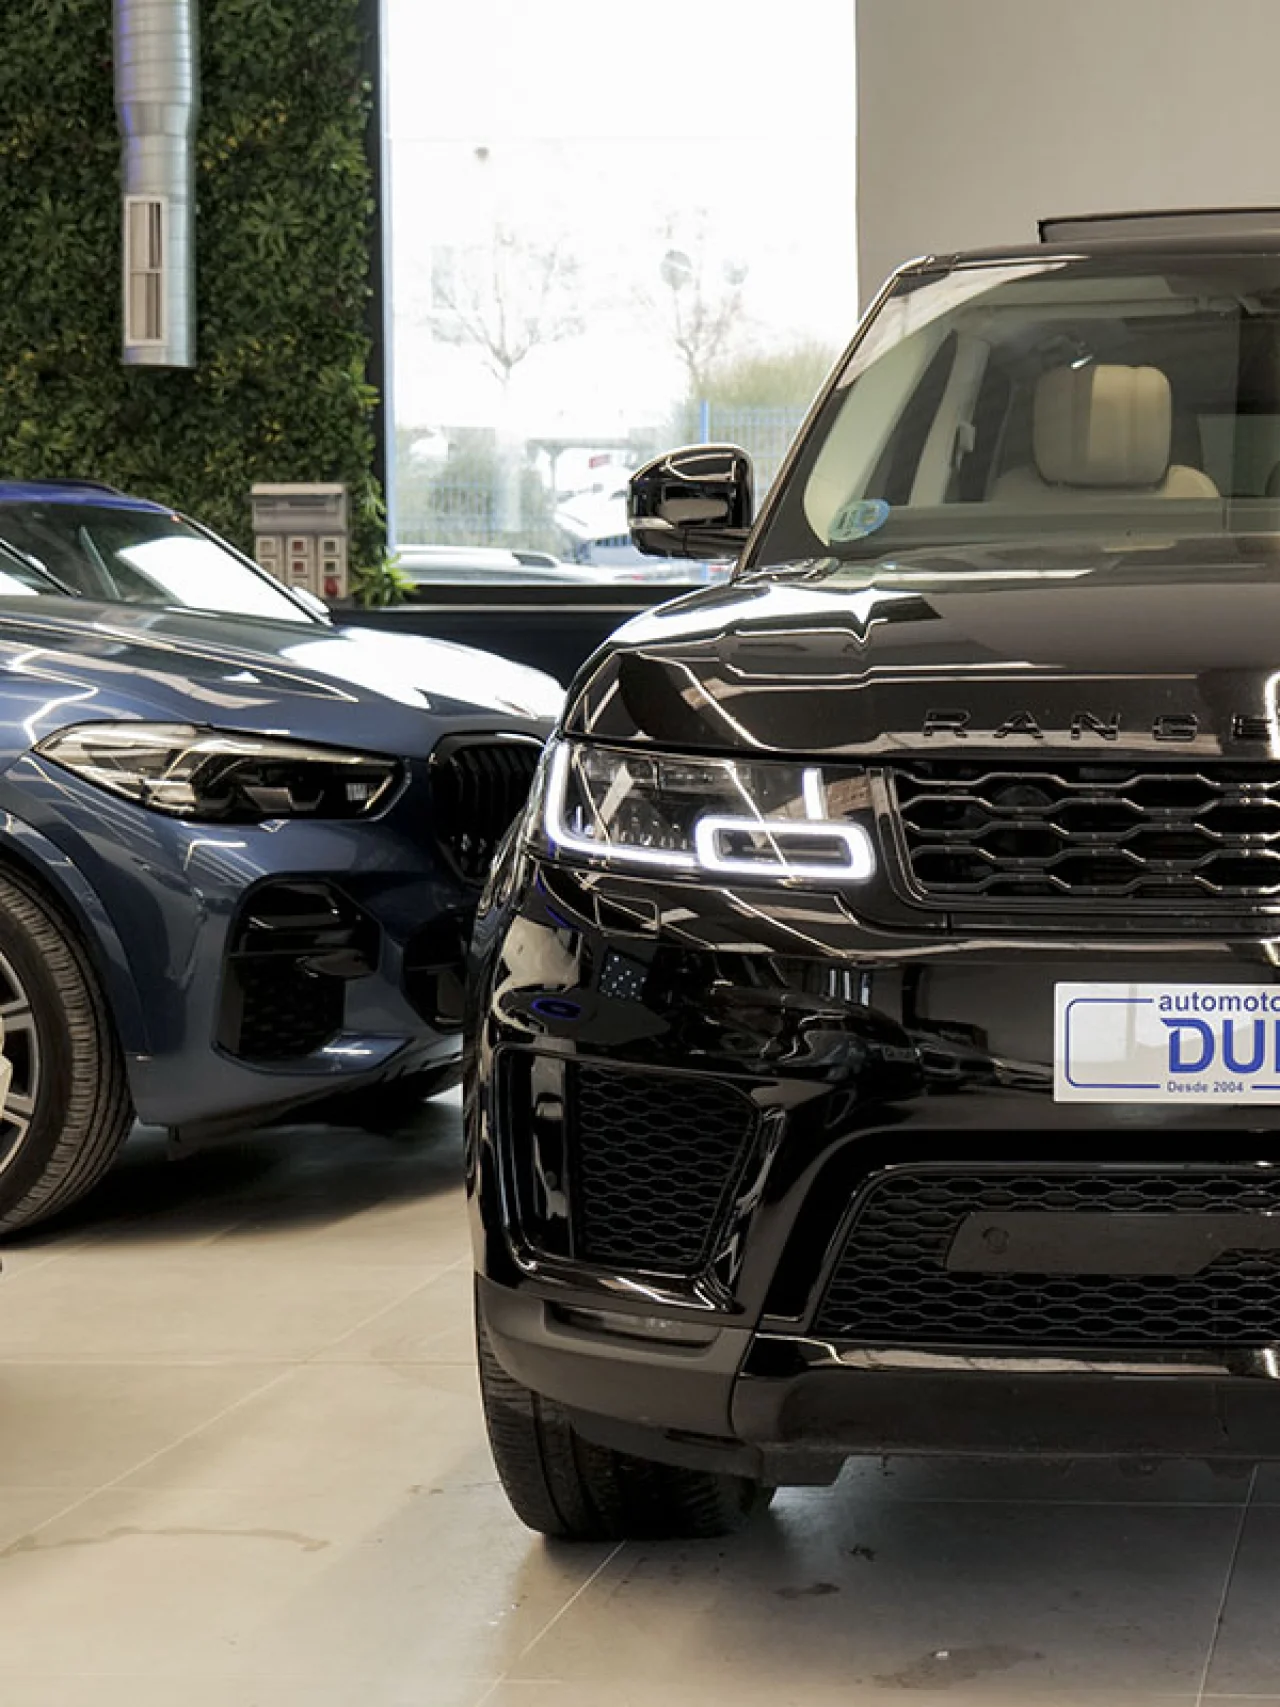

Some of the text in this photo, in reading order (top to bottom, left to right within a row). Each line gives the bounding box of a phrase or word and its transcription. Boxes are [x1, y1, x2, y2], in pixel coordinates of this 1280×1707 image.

[922, 707, 1273, 742] RANGE
[1167, 1081, 1244, 1093] Desde 2004
